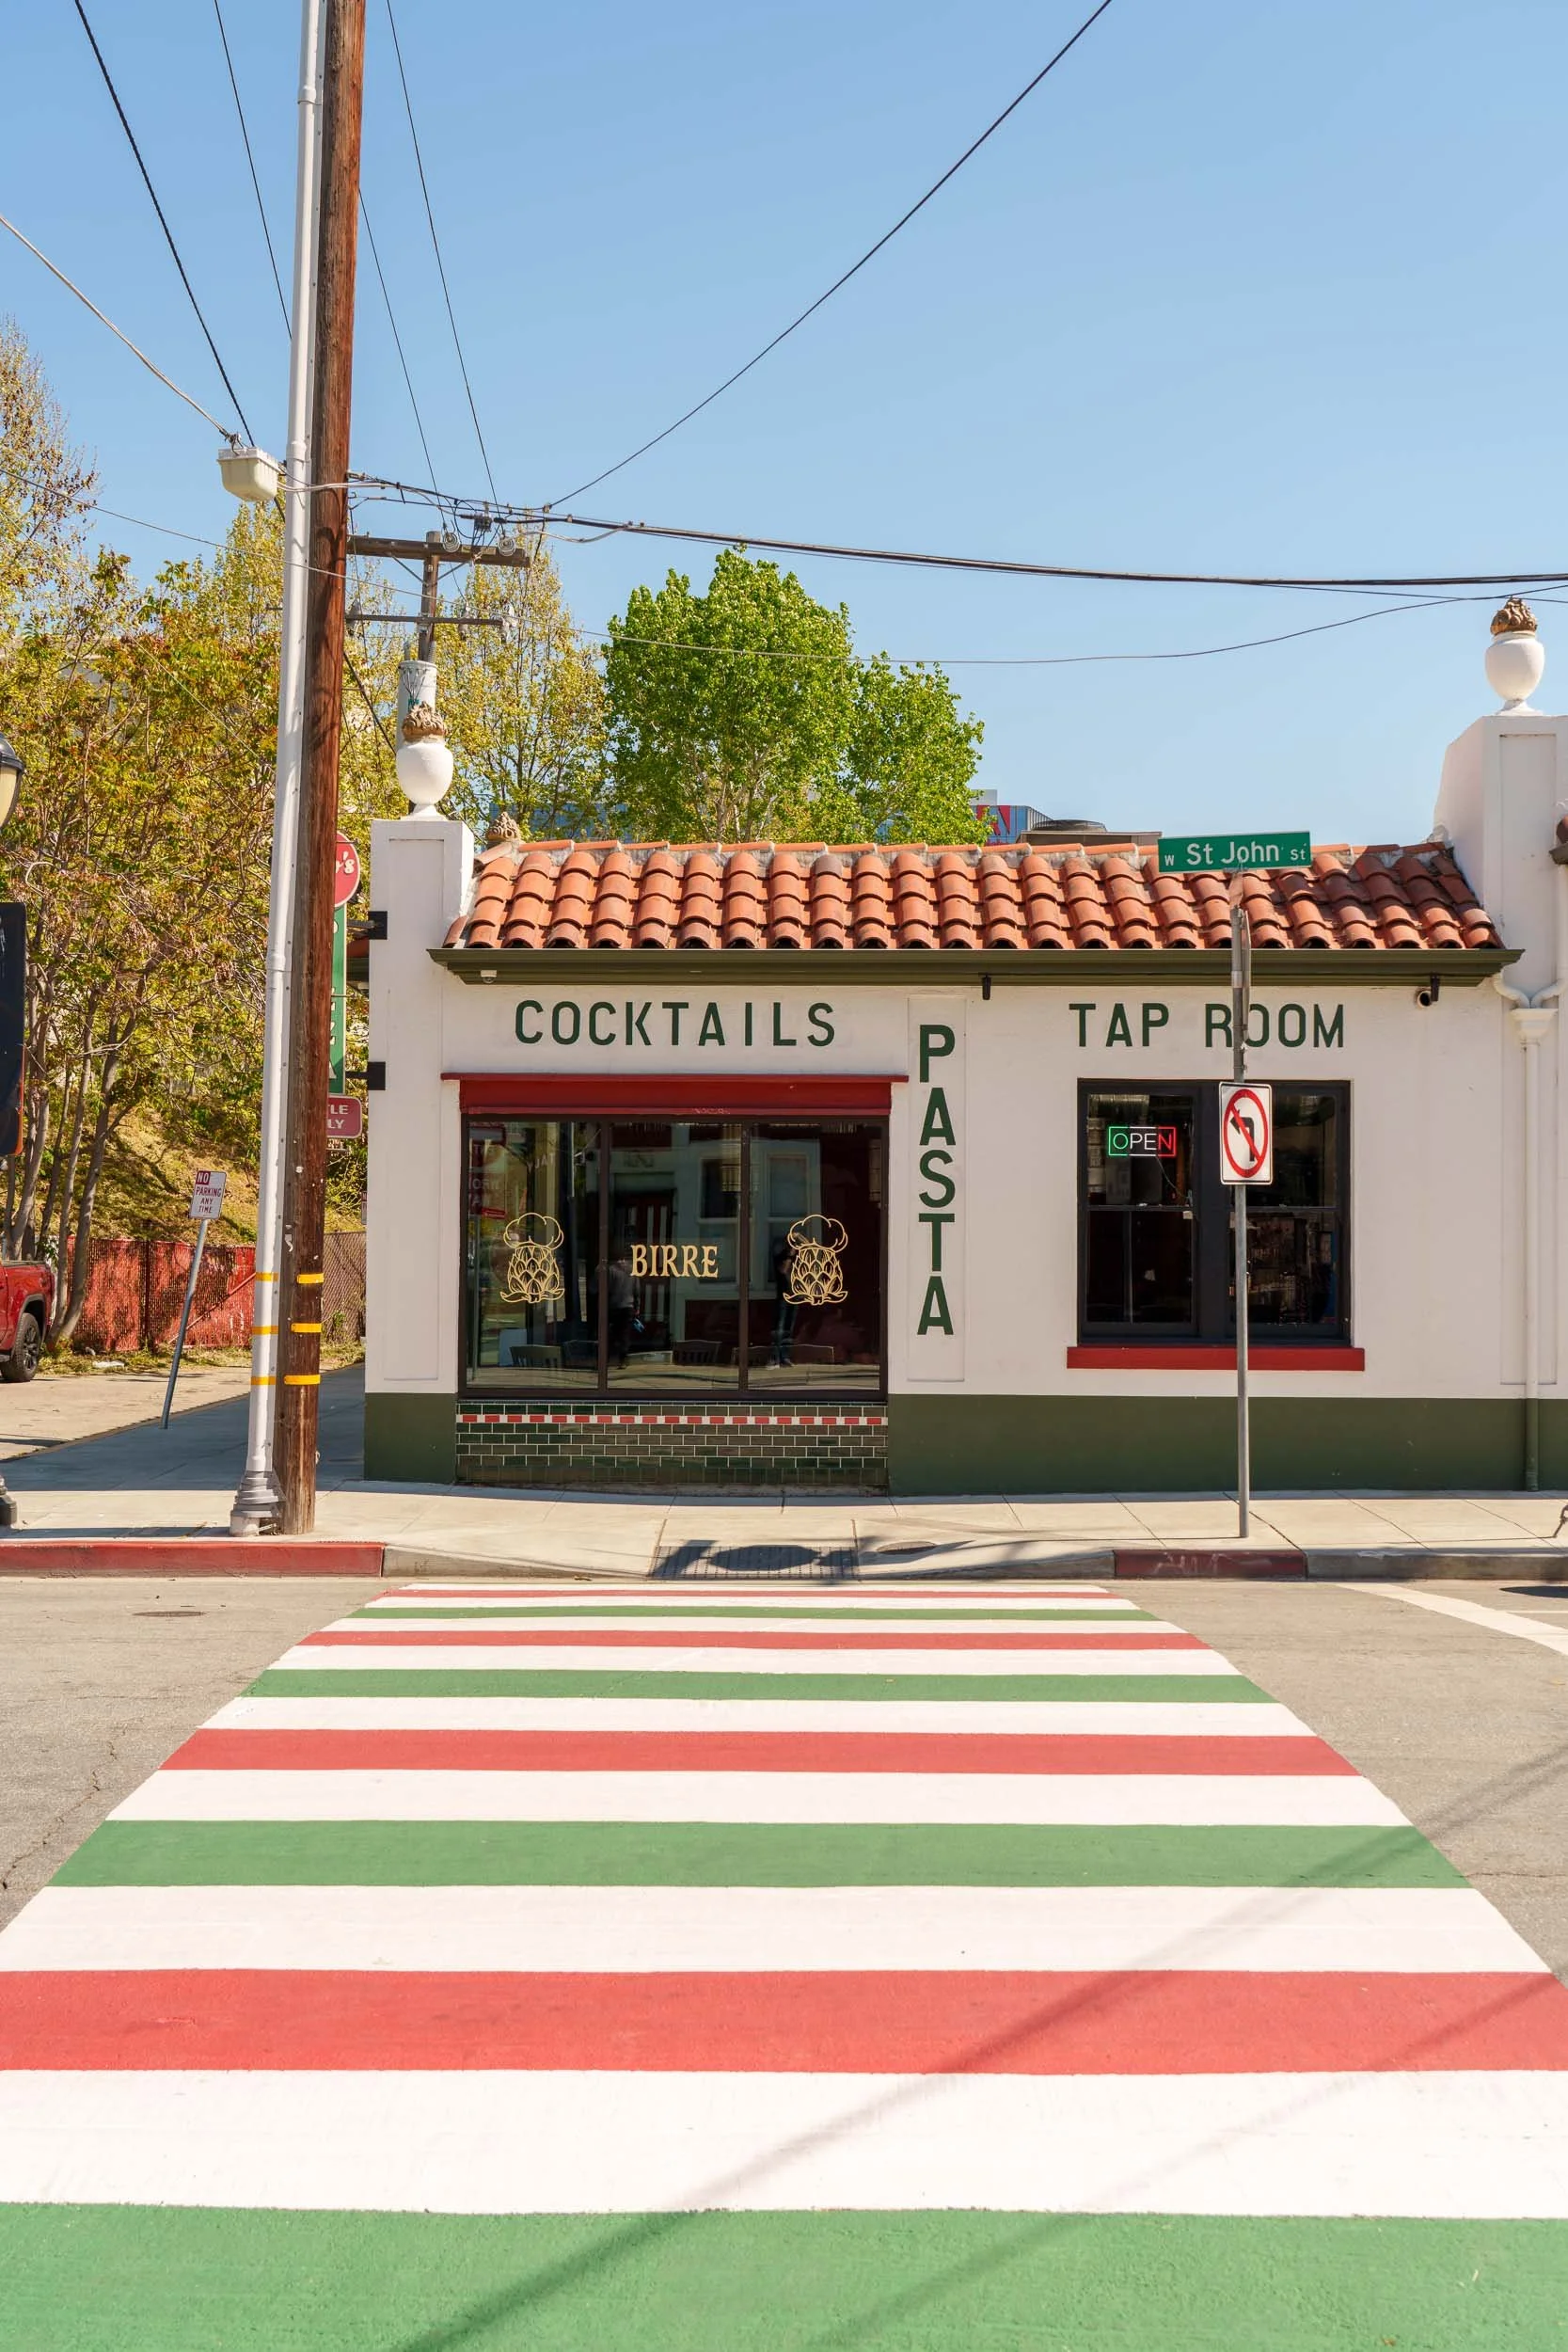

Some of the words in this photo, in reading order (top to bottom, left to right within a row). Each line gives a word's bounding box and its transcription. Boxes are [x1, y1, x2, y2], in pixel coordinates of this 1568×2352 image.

[1164, 854, 1175, 866] W
[1187, 842, 1214, 870] St
[1221, 840, 1280, 865] John
[1290, 848, 1306, 861] St
[515, 999, 835, 1047] COCKTAILS
[1068, 1002, 1170, 1048] TAP
[1205, 1003, 1344, 1048] ROOM
[1113, 1133, 1172, 1150] OPEN
[196, 1186, 222, 1198] PARKING
[197, 1172, 210, 1184] NO
[916, 1024, 957, 1336] PASTA
[198, 1205, 213, 1214] TIME
[629, 1244, 719, 1279] BIRRE
